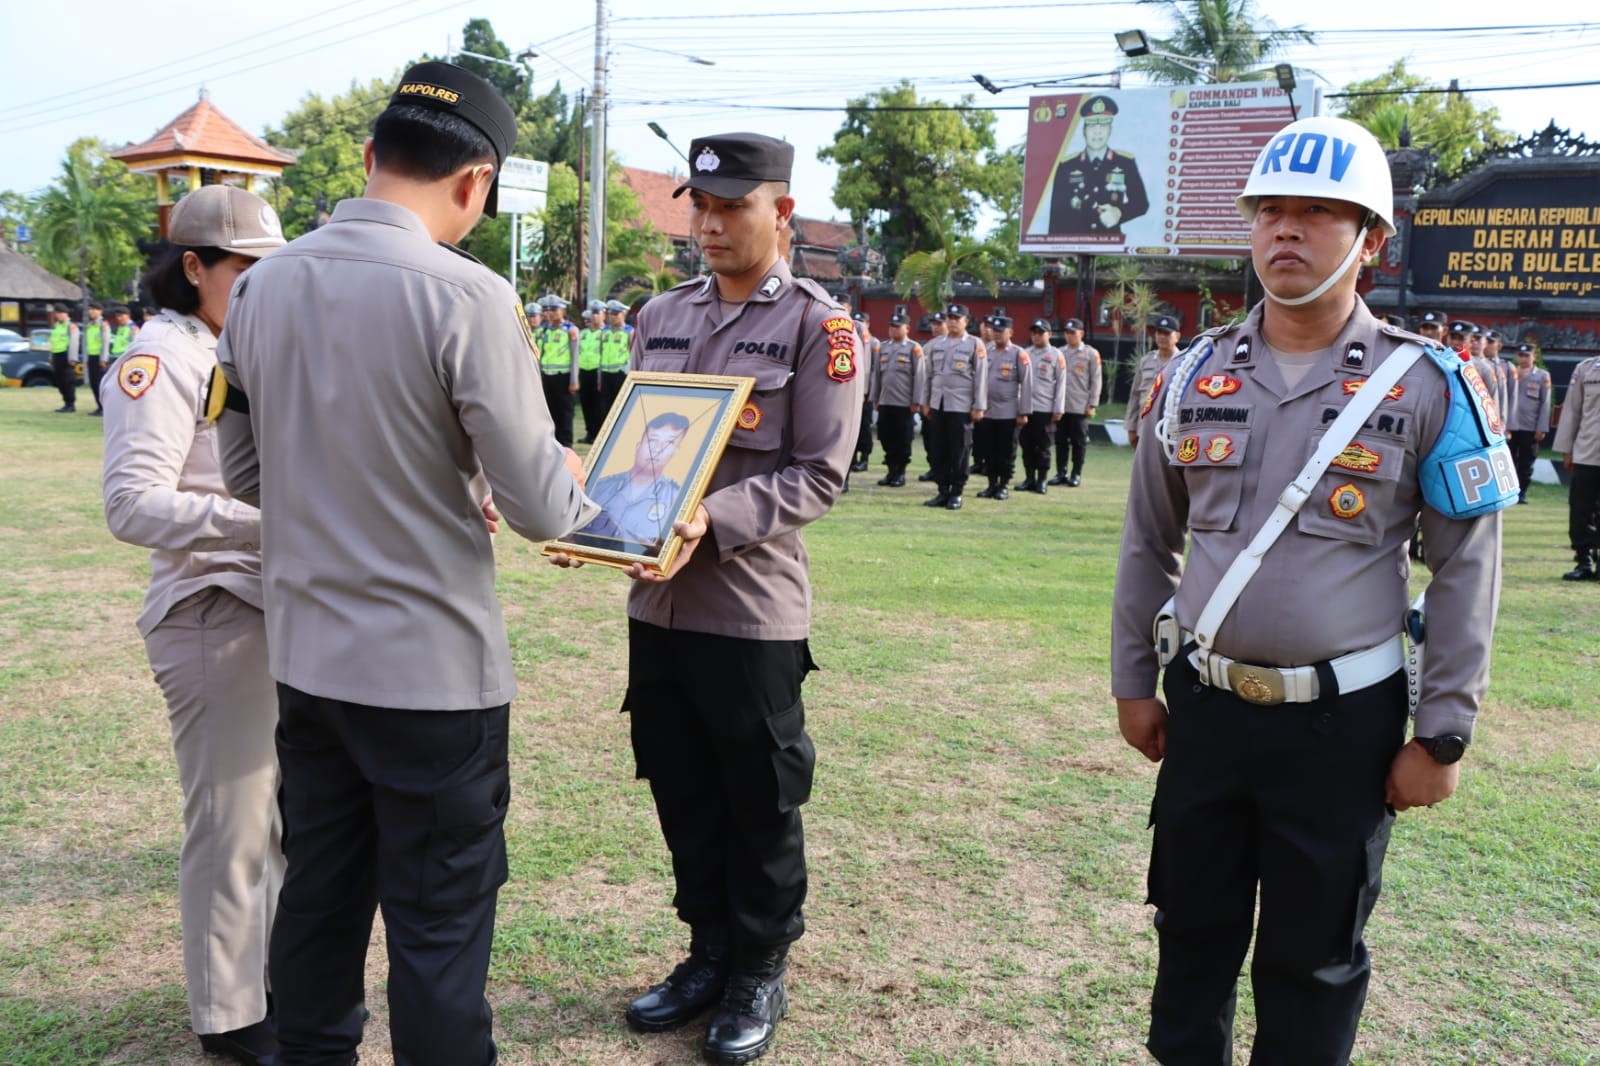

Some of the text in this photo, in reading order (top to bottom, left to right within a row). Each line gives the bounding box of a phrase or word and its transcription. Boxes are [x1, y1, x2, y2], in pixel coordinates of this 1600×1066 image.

[400, 84, 459, 103] KAPOLRES
[1189, 87, 1289, 100] COMMANDER WIS
[1189, 101, 1221, 109] KAPOLDA
[1414, 208, 1485, 226] KEPOLISIAN
[1488, 208, 1536, 226] NEGARA
[1473, 229, 1554, 249] DAERAH
[1448, 252, 1514, 271] RESOR
[734, 341, 788, 360] POLRI
